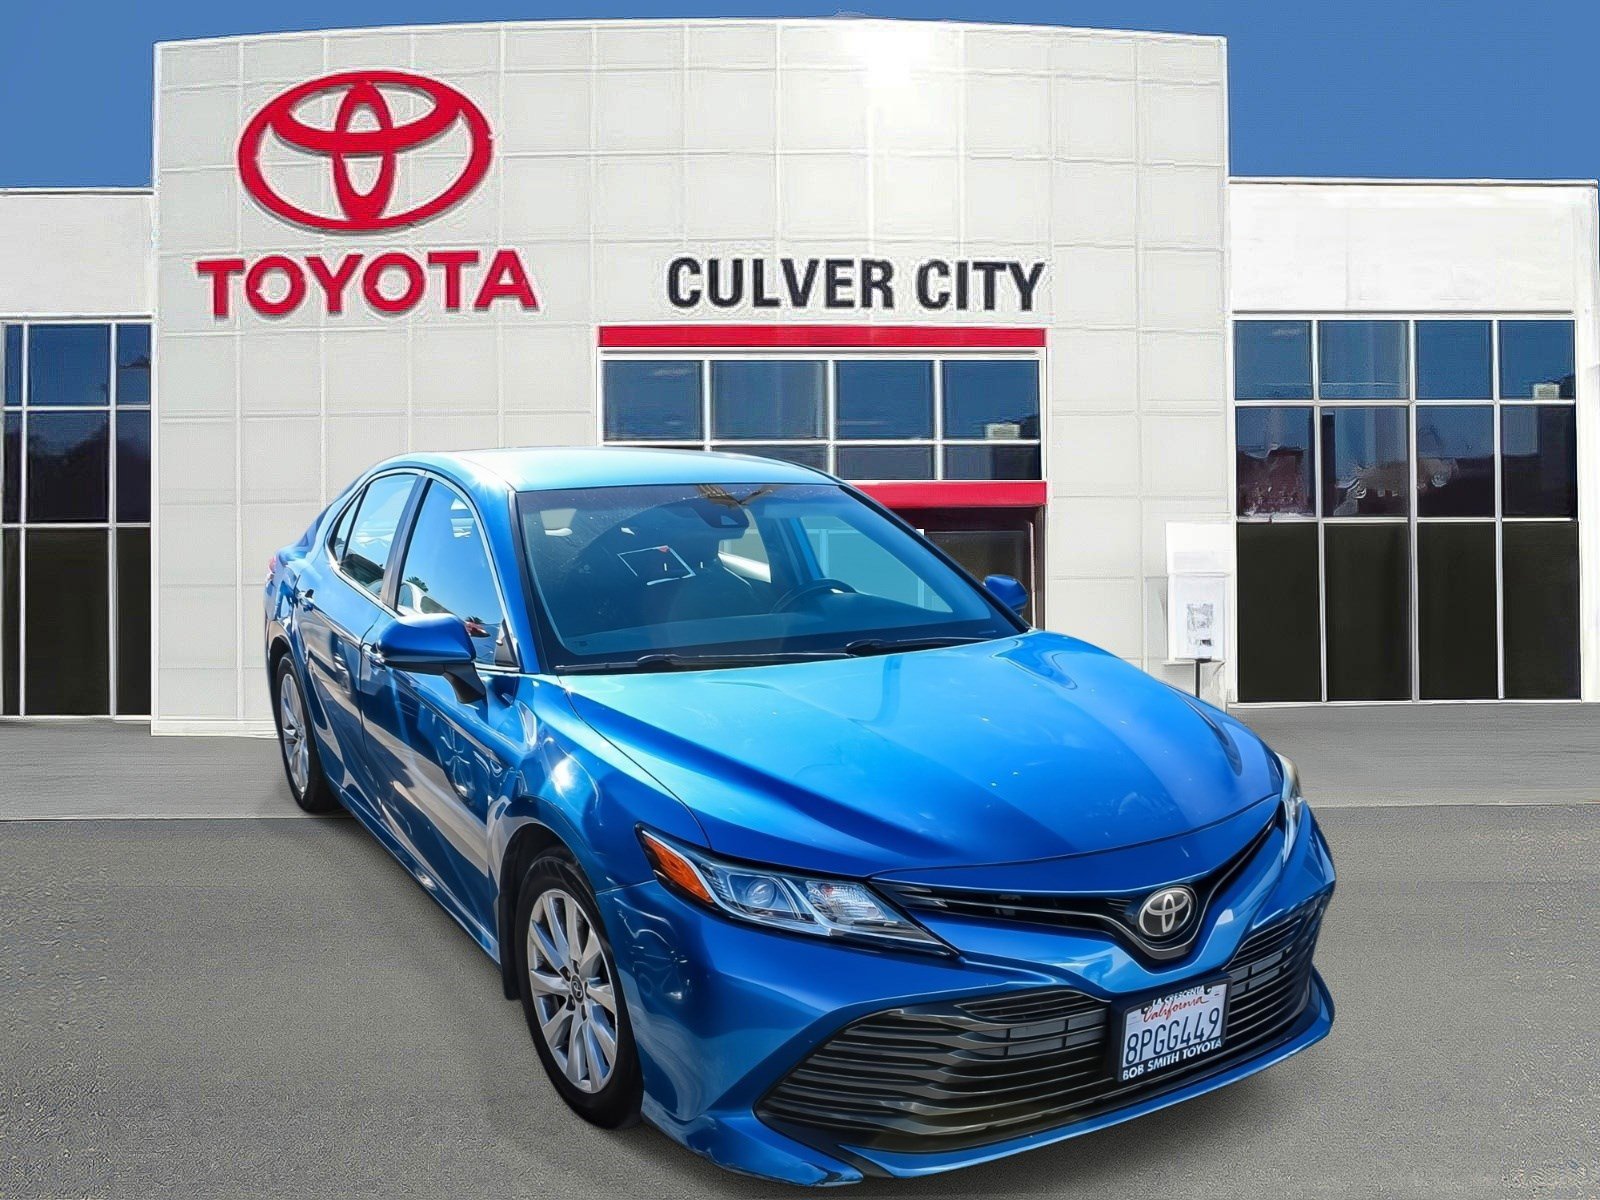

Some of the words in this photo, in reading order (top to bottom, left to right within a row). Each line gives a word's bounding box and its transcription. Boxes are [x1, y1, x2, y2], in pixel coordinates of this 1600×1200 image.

[196, 250, 538, 318] TOYOTA
[667, 257, 895, 309] CULVER
[916, 259, 1046, 311] CITY
[1143, 996, 1209, 1022] California
[1122, 1064, 1144, 1080] BOB
[1147, 1051, 1180, 1072] SMITH
[1182, 1038, 1222, 1060] TOYOTA
[1125, 1008, 1220, 1065] 8PGG449
